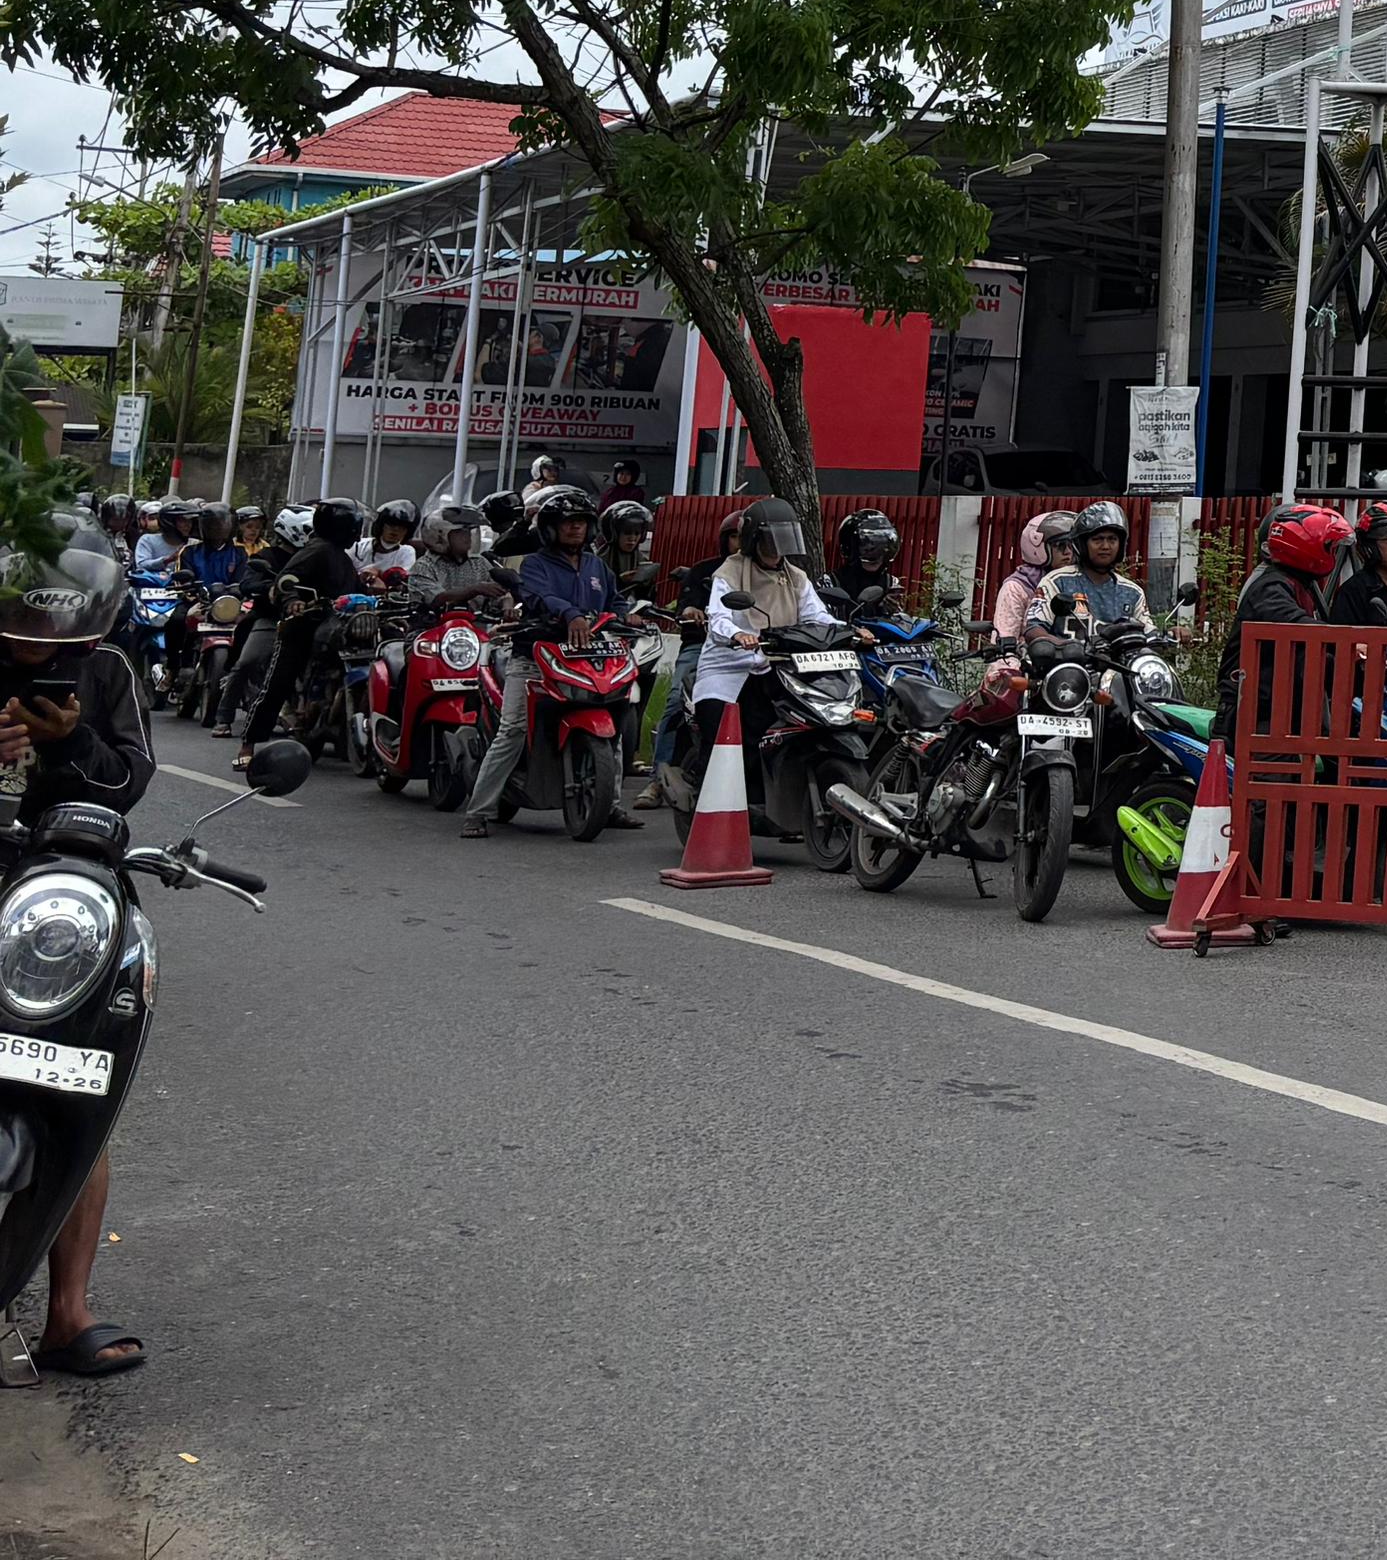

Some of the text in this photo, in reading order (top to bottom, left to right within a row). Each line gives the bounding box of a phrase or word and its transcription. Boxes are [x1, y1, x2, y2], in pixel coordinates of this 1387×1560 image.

[536, 266, 637, 288] ERVICE
[769, 269, 824, 284] ROMO
[533, 287, 638, 307] ERMURAH
[763, 283, 851, 302] ERBESAR
[423, 388, 486, 404] STAT
[490, 391, 545, 407] FOM
[551, 393, 586, 407] 900
[590, 394, 662, 411] RIBUAN
[424, 402, 493, 417] BOUS
[1138, 409, 1191, 424] pastikan
[522, 424, 562, 436] JUTA
[1171, 422, 1190, 431] kita
[796, 653, 834, 664] DA 6721
[1020, 716, 1089, 728] DA 4592 ST
[72, 814, 111, 829] HONDA
[79, 1051, 109, 1072] YA
